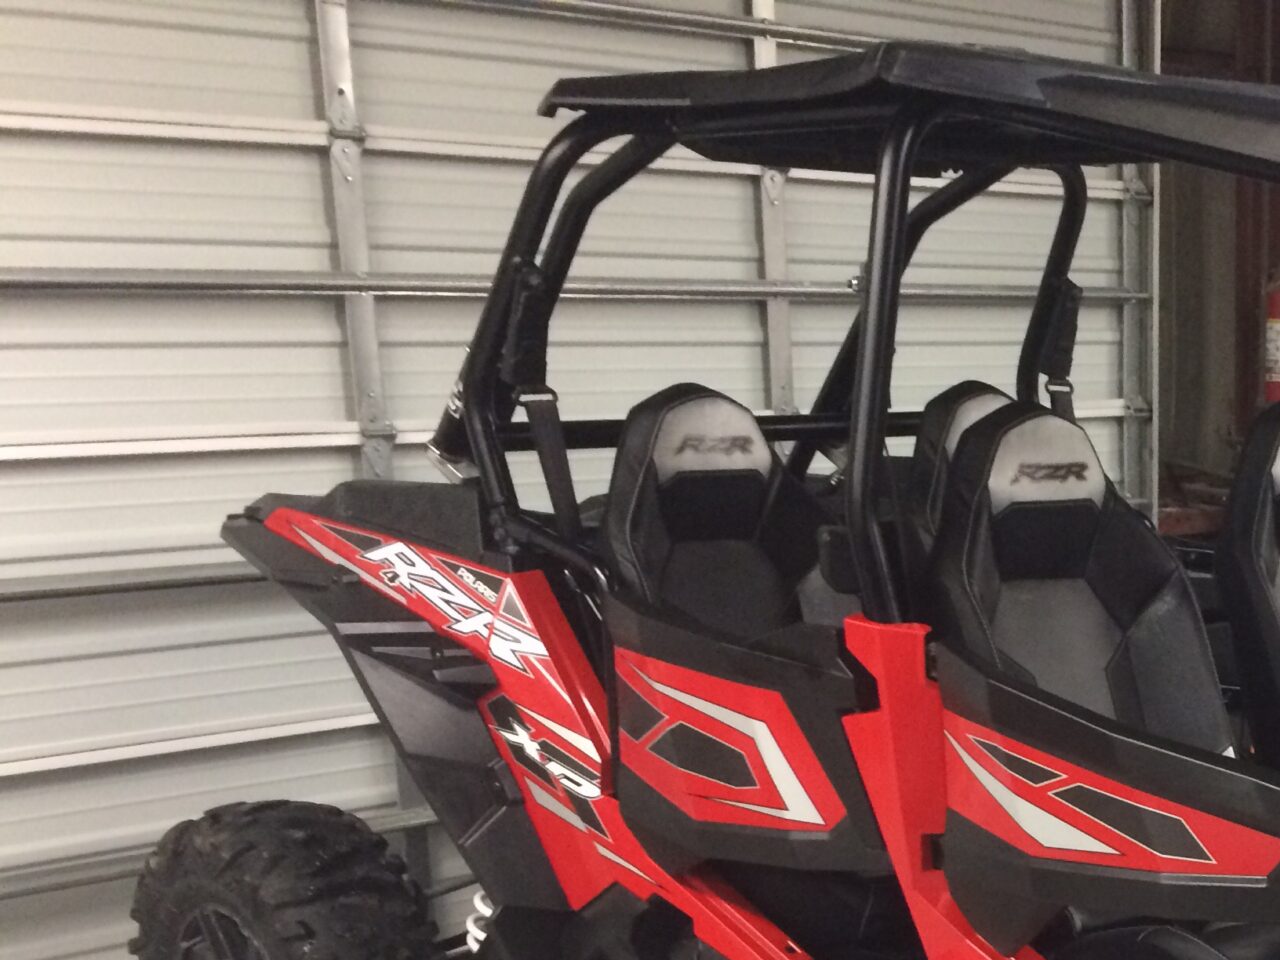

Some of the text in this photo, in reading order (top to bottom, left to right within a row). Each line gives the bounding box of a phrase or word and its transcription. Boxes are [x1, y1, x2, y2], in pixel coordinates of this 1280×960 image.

[674, 434, 754, 456] RZR
[1010, 462, 1088, 486] RZR
[457, 566, 500, 604] POLARIS
[361, 541, 551, 674] RZR
[499, 721, 602, 799] XP
